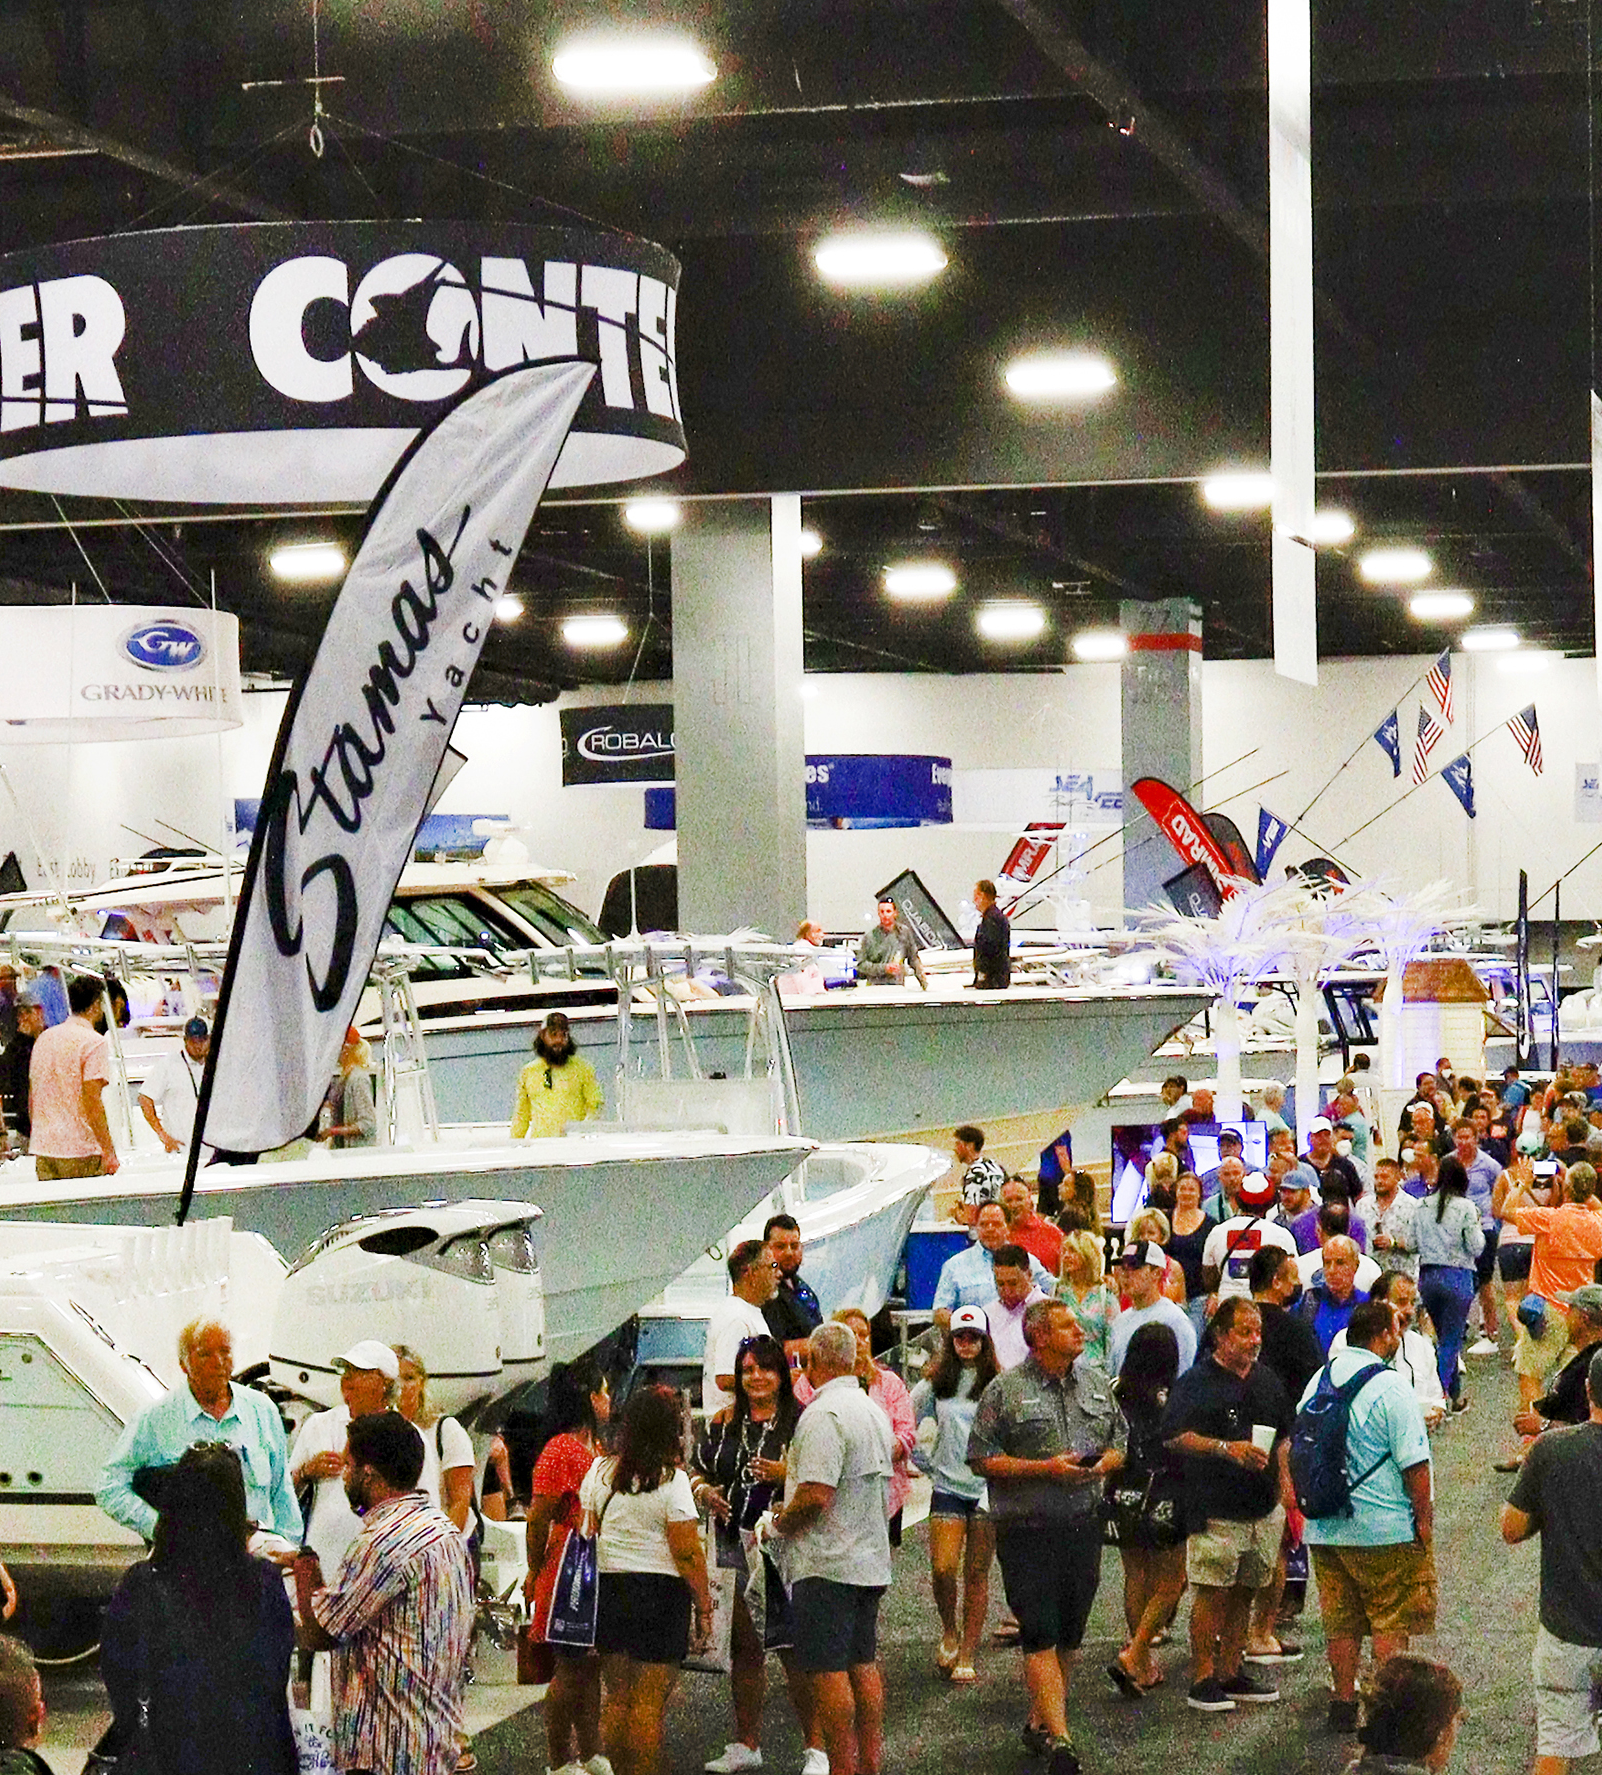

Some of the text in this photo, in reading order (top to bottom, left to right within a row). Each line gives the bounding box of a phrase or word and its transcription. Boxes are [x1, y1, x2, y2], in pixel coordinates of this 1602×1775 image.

[420, 538, 513, 727] Yacht
[264, 504, 471, 1013] Stamas
[306, 1278, 432, 1306] SUZUKI
